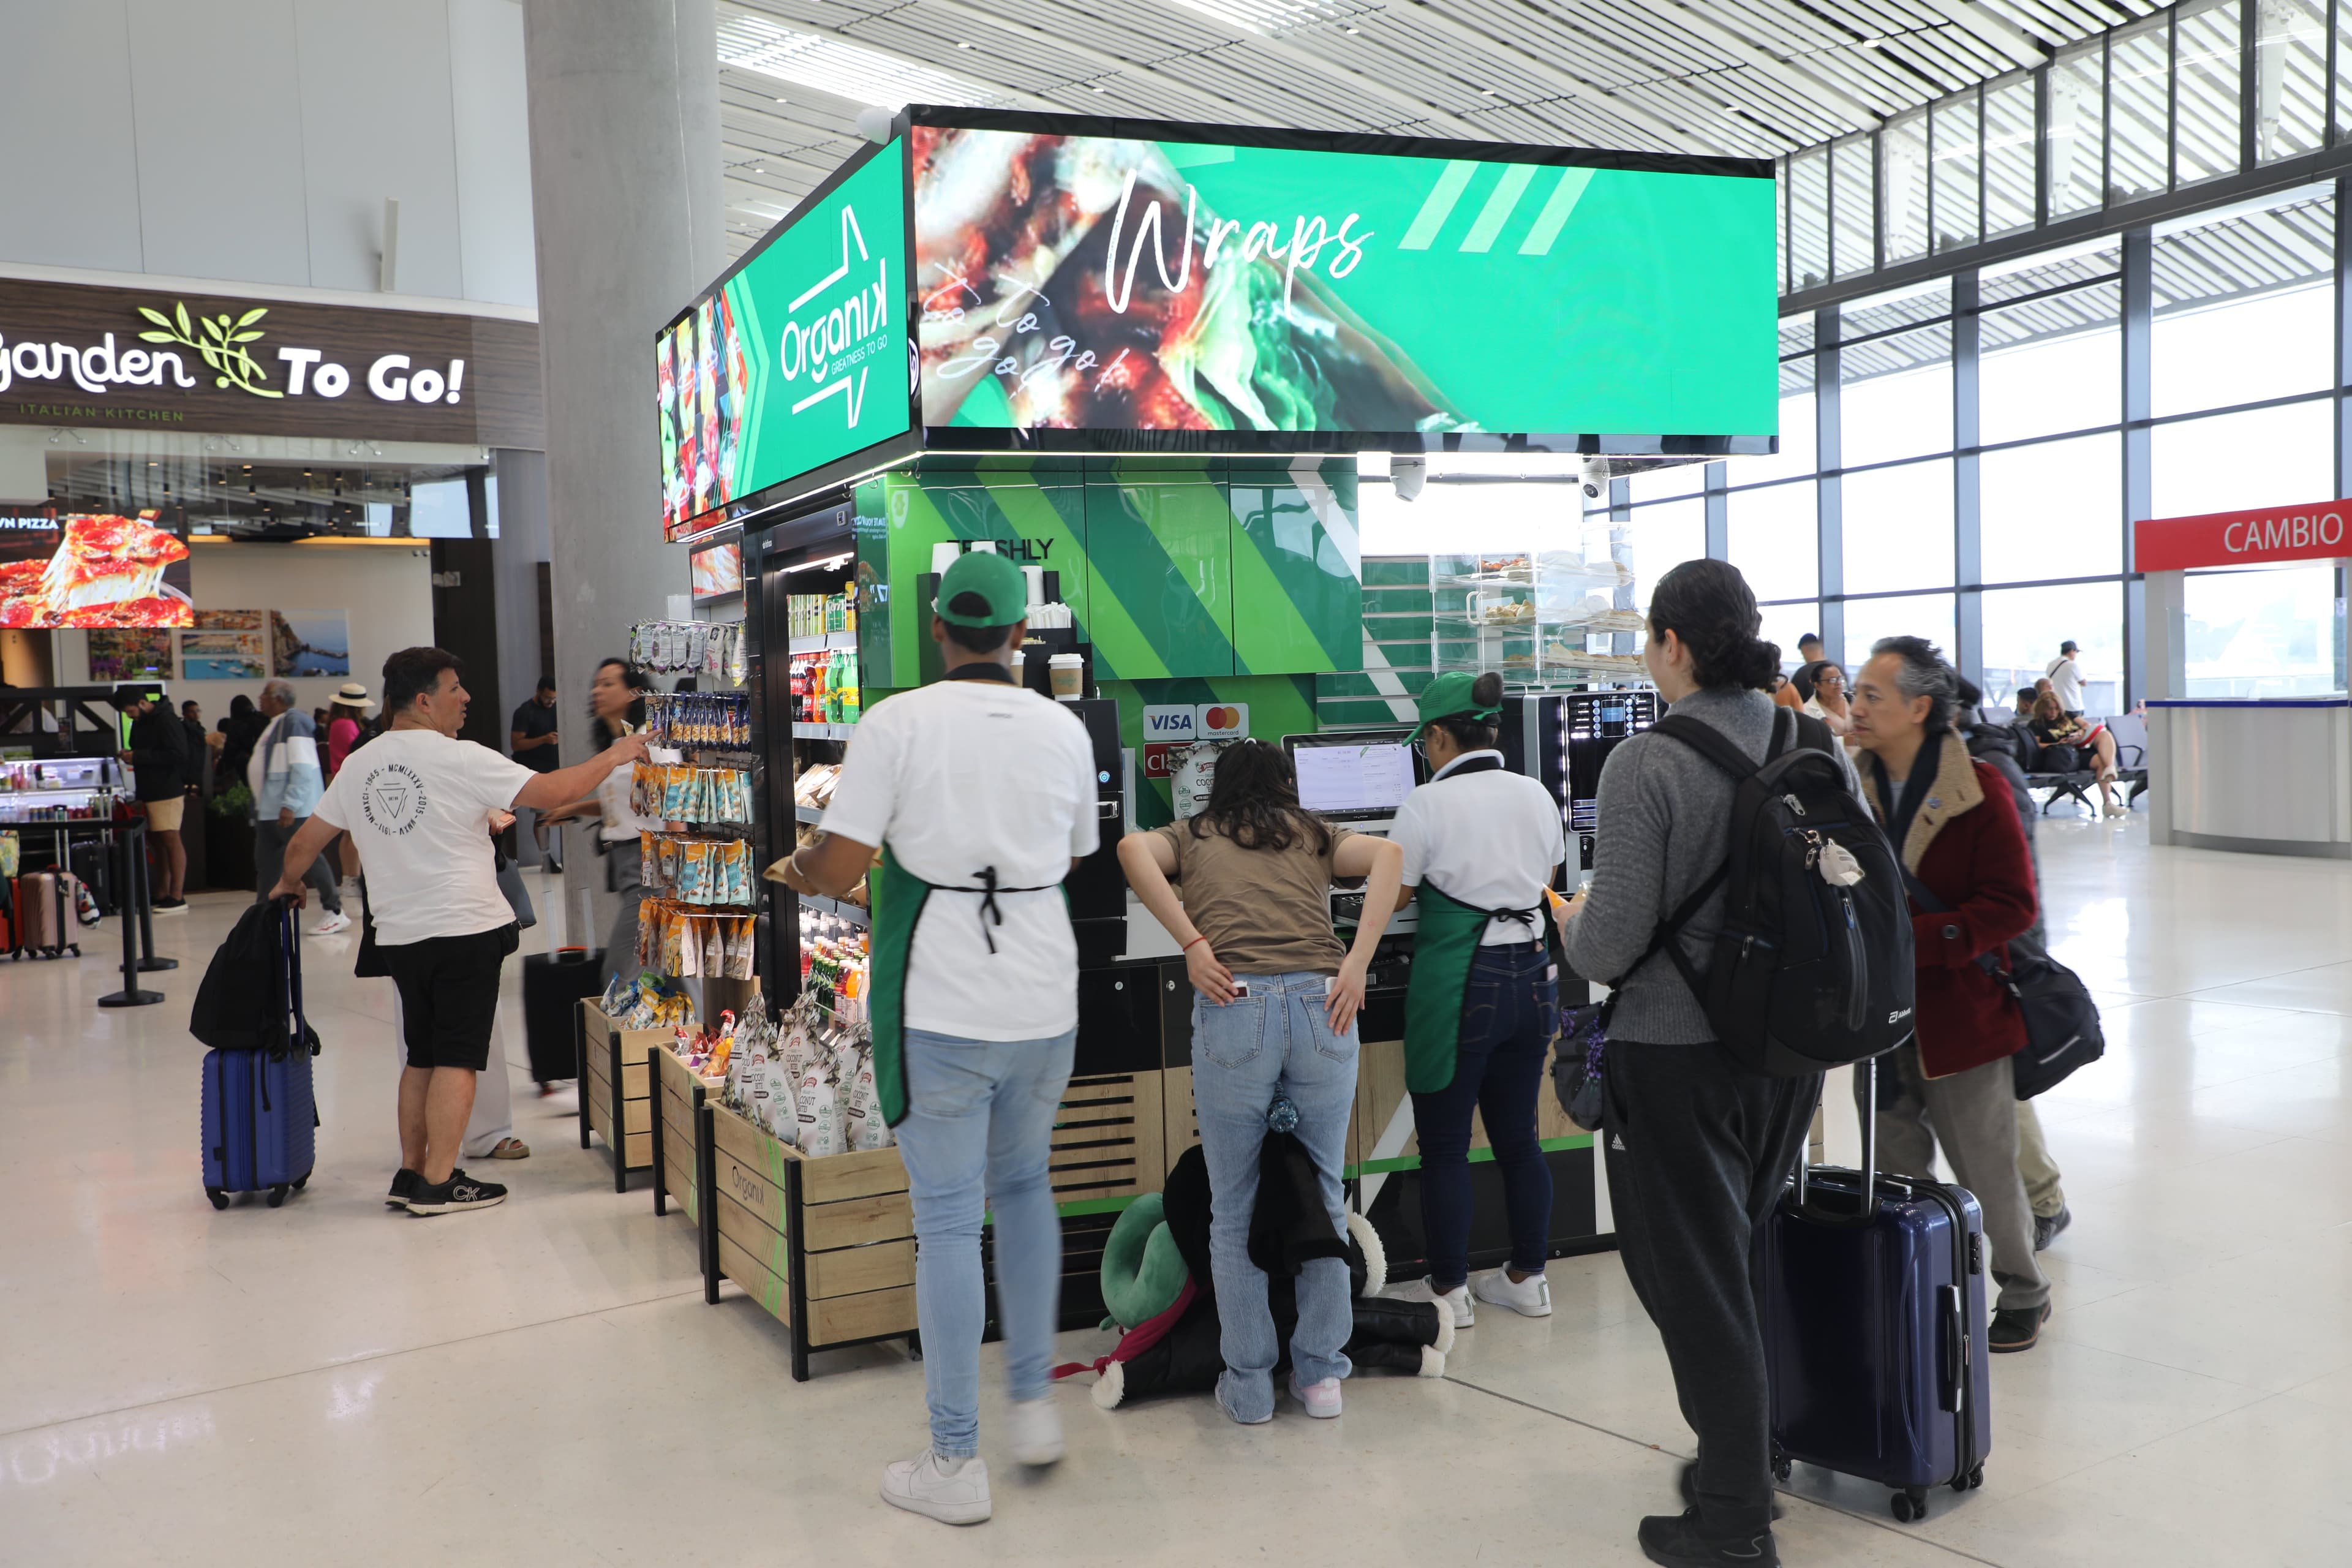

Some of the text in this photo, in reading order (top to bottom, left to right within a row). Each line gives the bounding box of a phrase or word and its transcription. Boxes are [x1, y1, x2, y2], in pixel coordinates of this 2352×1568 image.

[1106, 168, 1374, 319] Wraps
[831, 334, 888, 375] GREATNESS TO GO
[278, 347, 350, 398] To
[368, 354, 464, 404] Go!
[20, 404, 183, 421] ITALIAN KITCHEN
[18, 517, 59, 530] PIZZA
[2224, 513, 2343, 553] CAMBIO
[1148, 715, 1192, 729] VISA
[366, 769, 380, 786] 1985
[388, 764, 424, 789] MCMLXXXV
[416, 796, 427, 815] 2015
[799, 1096, 816, 1106] CONUT
[453, 1185, 480, 1201] CK
